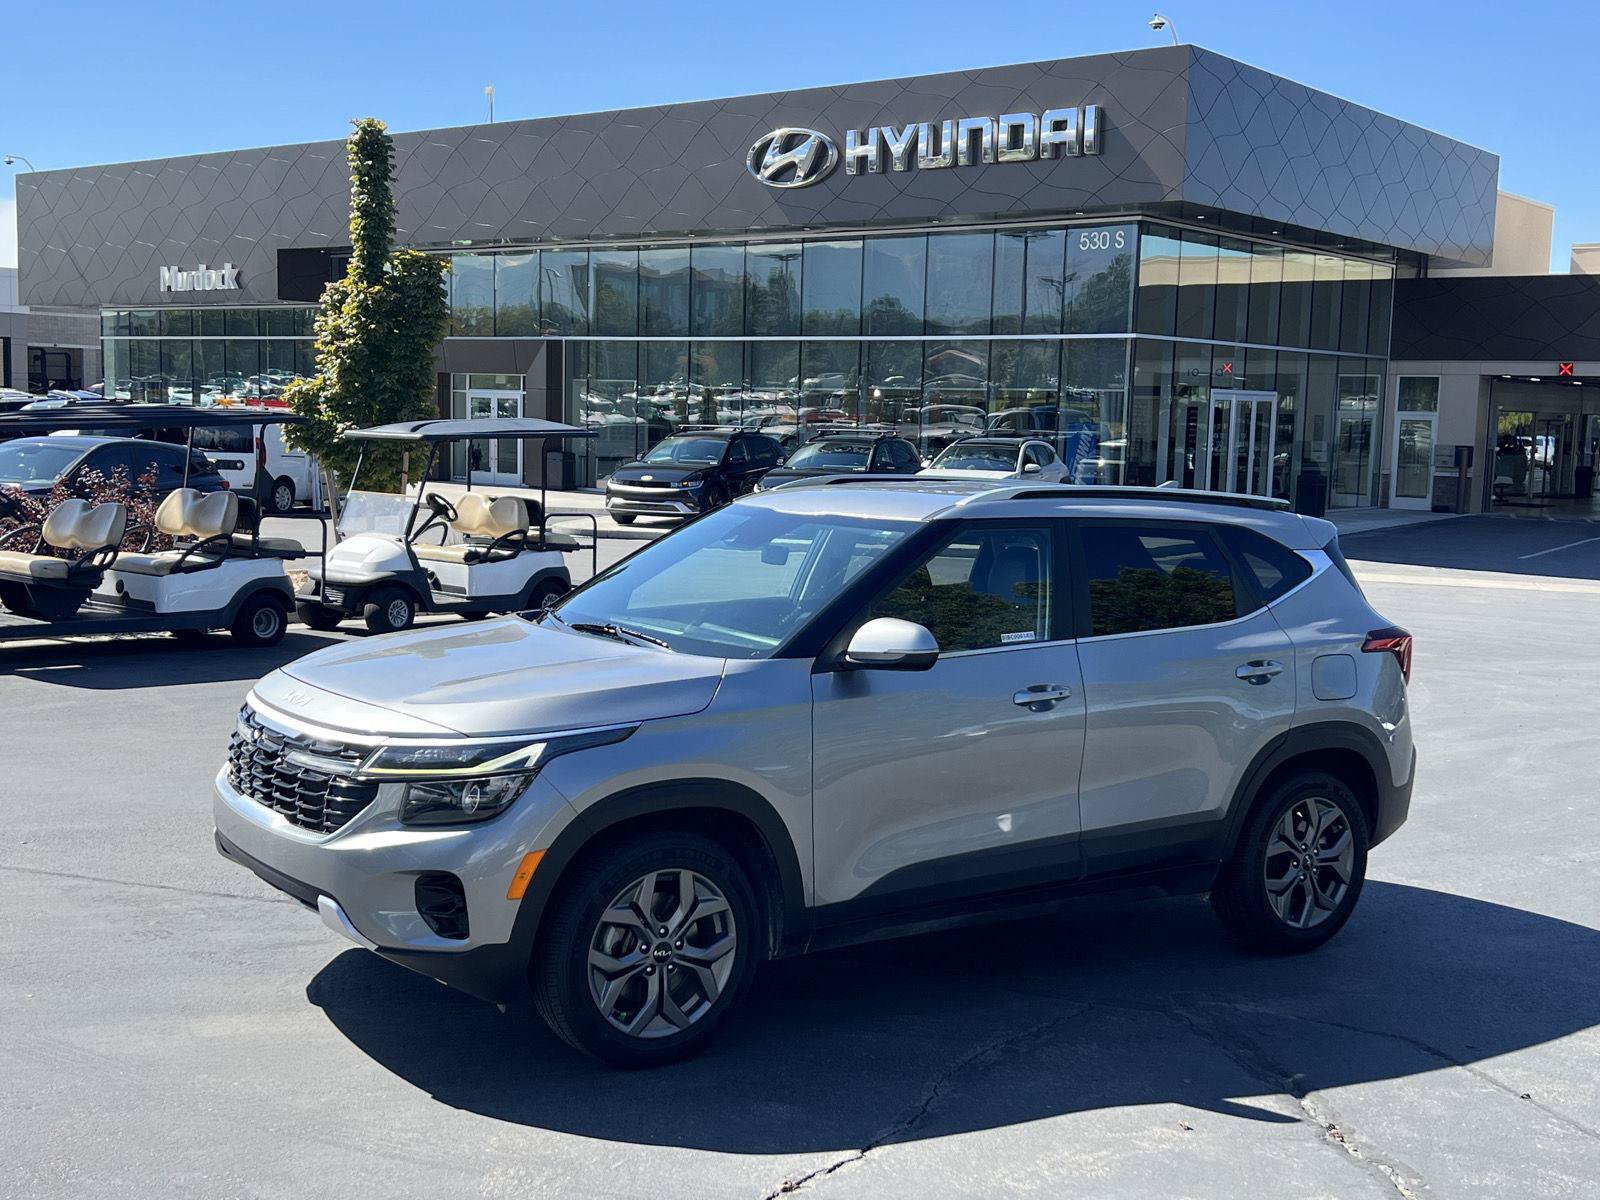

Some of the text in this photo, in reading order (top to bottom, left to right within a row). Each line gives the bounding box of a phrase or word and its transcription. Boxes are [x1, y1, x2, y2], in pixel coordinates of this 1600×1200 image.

[846, 104, 1102, 175] HYUNDAI
[1080, 230, 1125, 250] 530 S
[160, 262, 241, 292] Murdock
